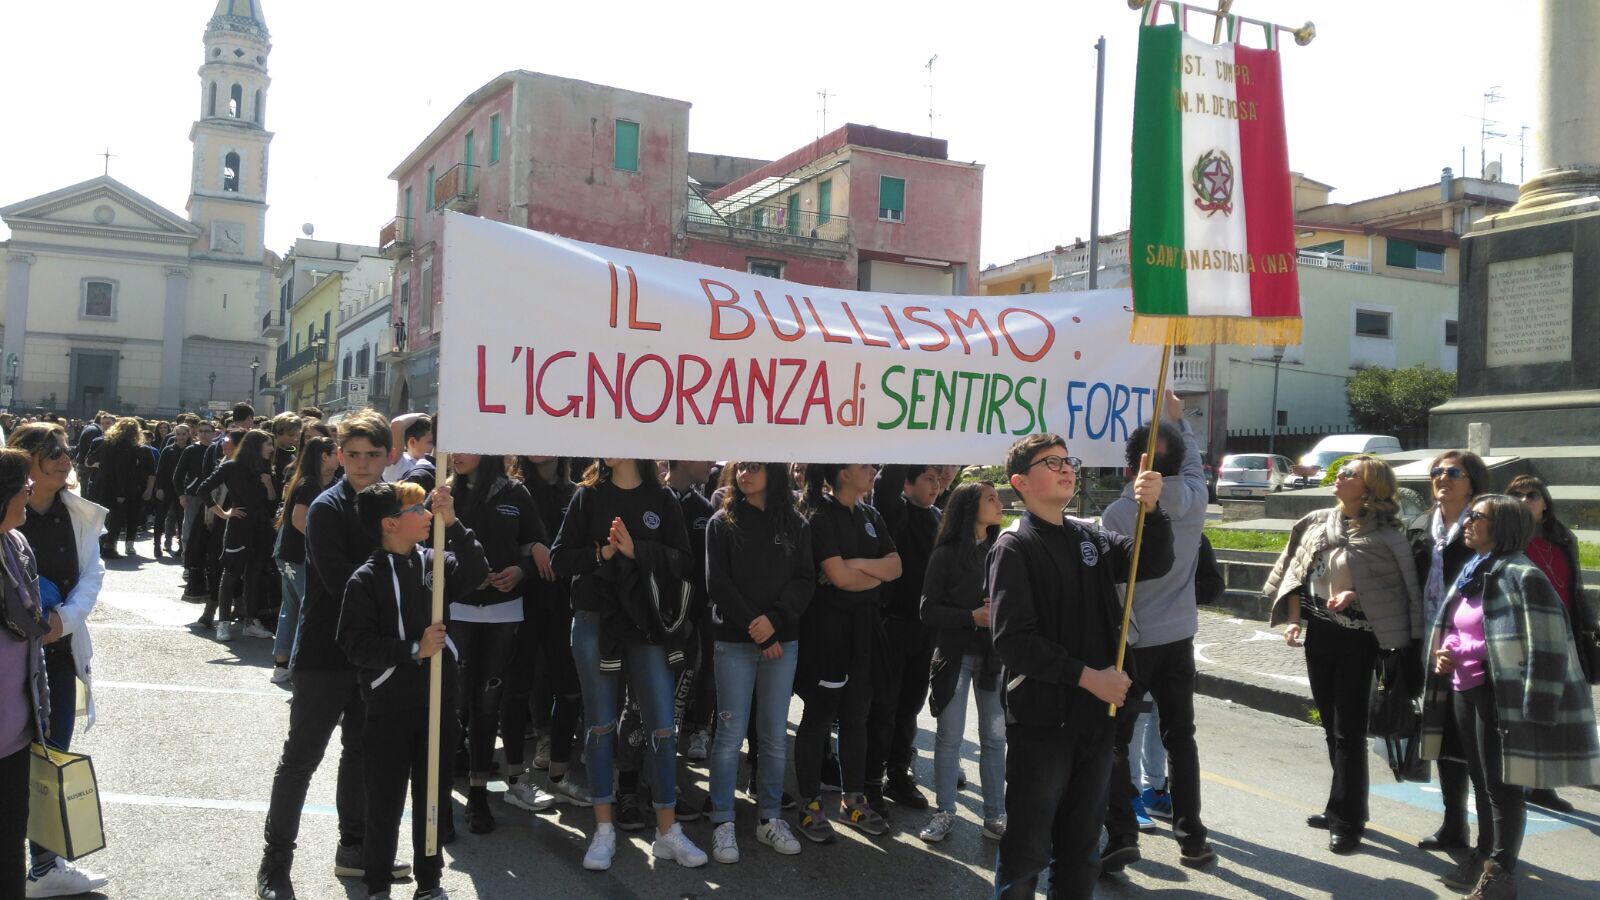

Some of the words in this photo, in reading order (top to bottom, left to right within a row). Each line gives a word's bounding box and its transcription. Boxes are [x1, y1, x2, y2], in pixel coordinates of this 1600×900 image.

[1196, 92, 1210, 114] M.
[608, 261, 662, 332] IL
[477, 345, 833, 426] L'IGNORANZA
[836, 362, 866, 427] di
[877, 365, 1047, 436] SENTIRSI
